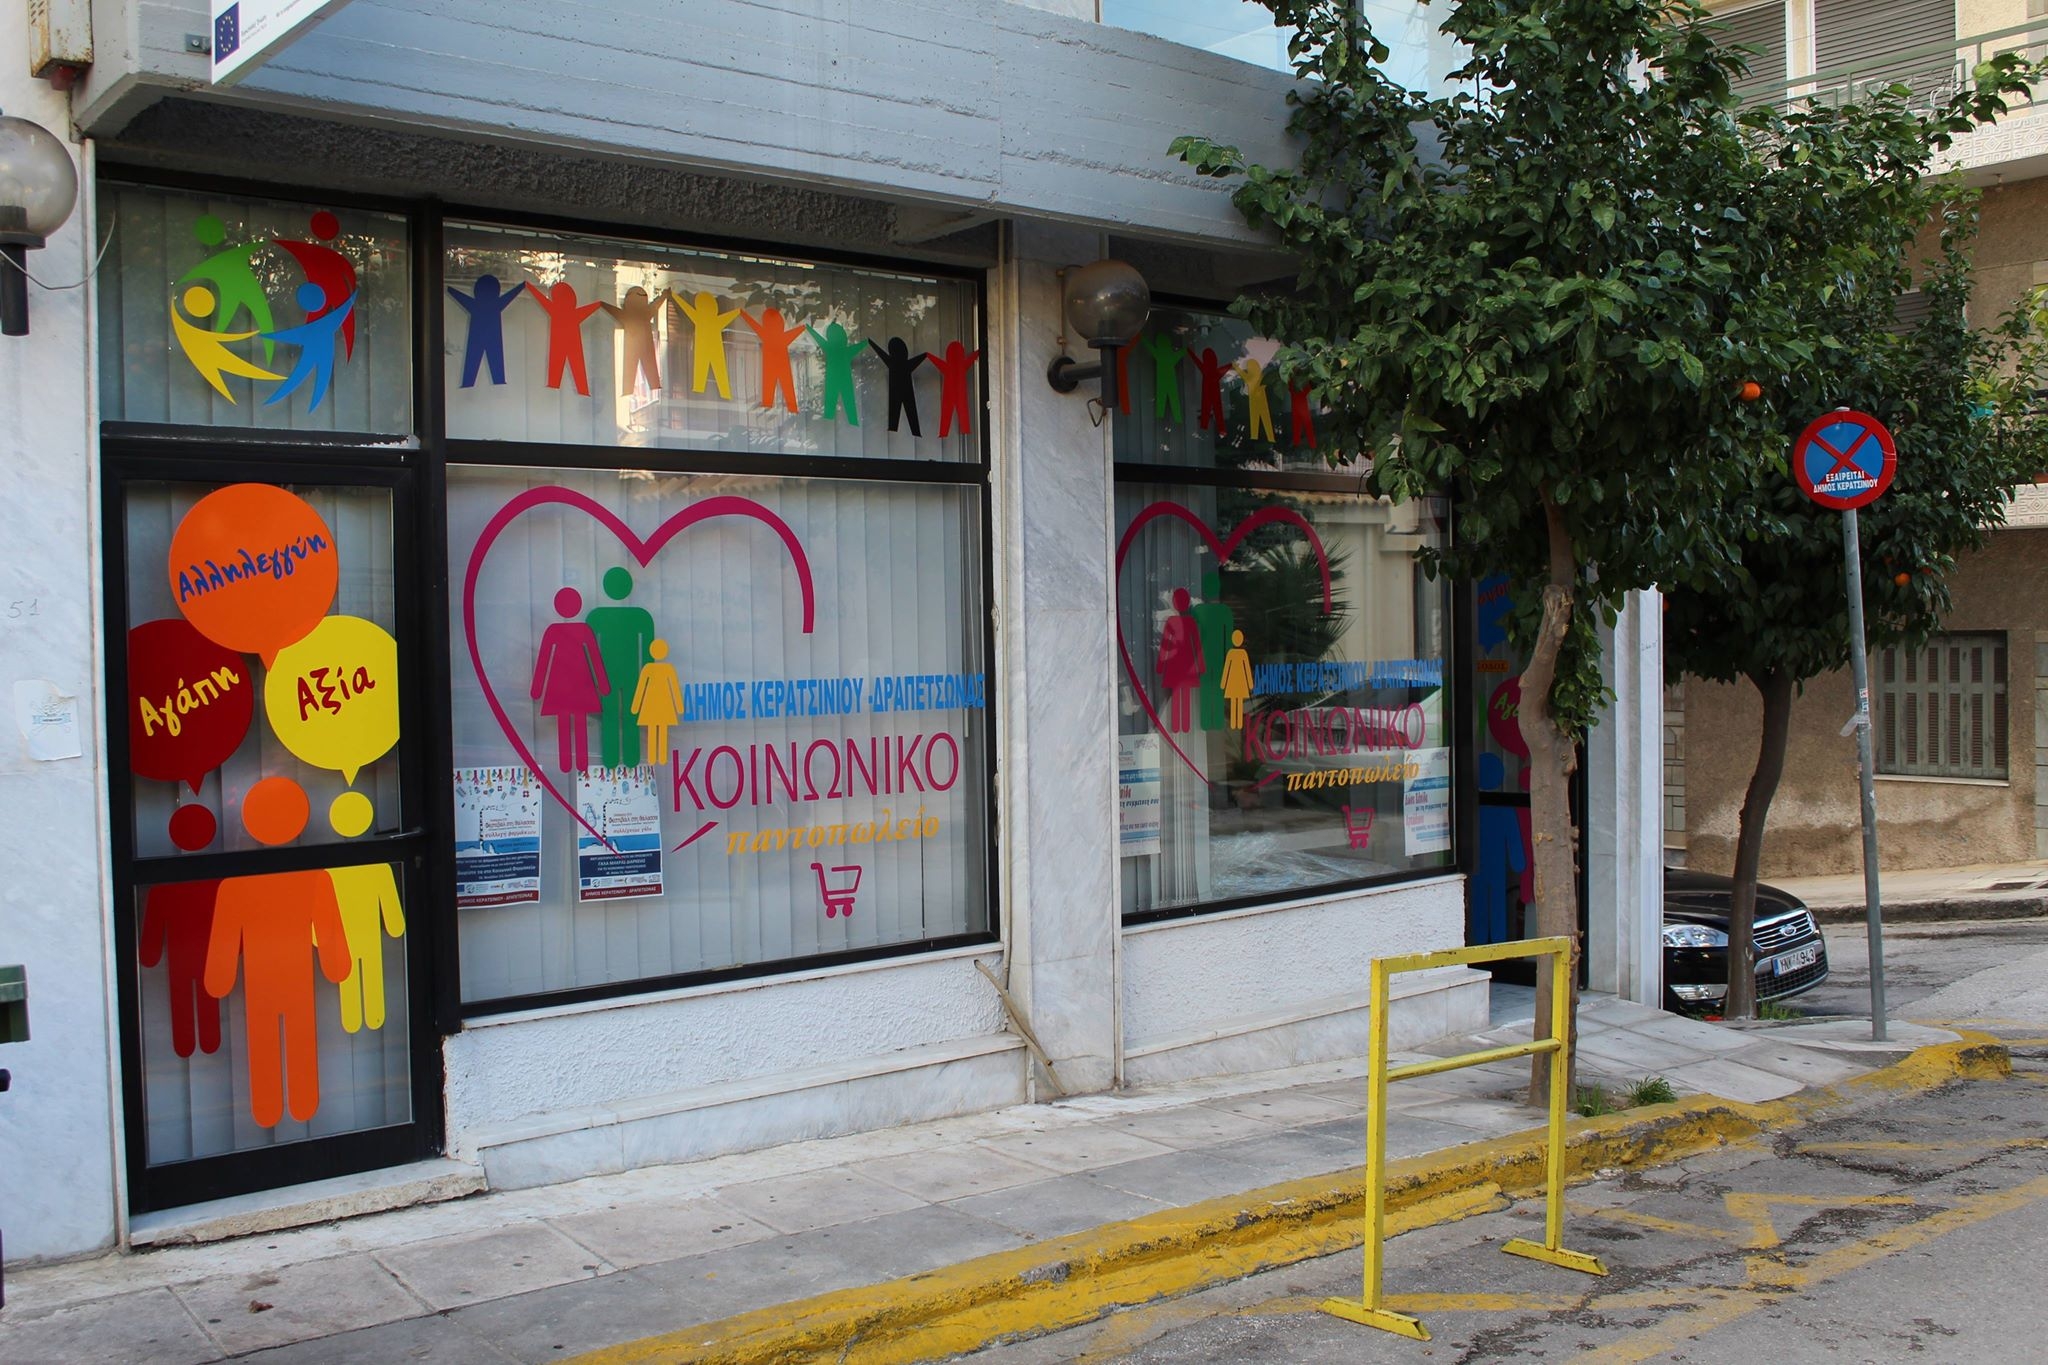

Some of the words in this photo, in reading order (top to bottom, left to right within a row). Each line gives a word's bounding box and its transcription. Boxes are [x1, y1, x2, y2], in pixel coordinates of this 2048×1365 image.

[1813, 483, 1836, 493] ΔΗΜΟΣ
[1837, 479, 1878, 491] ΚΕΡΑΤΣΙΝΙΟΥ
[1825, 470, 1865, 482] ΕΞΑΙΡΕΙΤΑΙ
[178, 534, 328, 603] Αλληλεγγύη
[139, 666, 240, 737] Αγάπη
[297, 666, 376, 721] Αξία
[683, 681, 746, 722] ΔΗΜΟΣ
[752, 677, 863, 719] ΚΕΡΑΤΣΙΝΙΟΥ
[1253, 663, 1294, 695] ΔΗΜΟΣ
[1244, 703, 1425, 762] ΚΟΙΝΩΝΙΚΟ
[671, 732, 959, 812] ΚΟΙΝΩΝΙΚΟ
[1286, 755, 1420, 792] παντοπωλείο
[725, 804, 940, 855] παντοπωλείο
